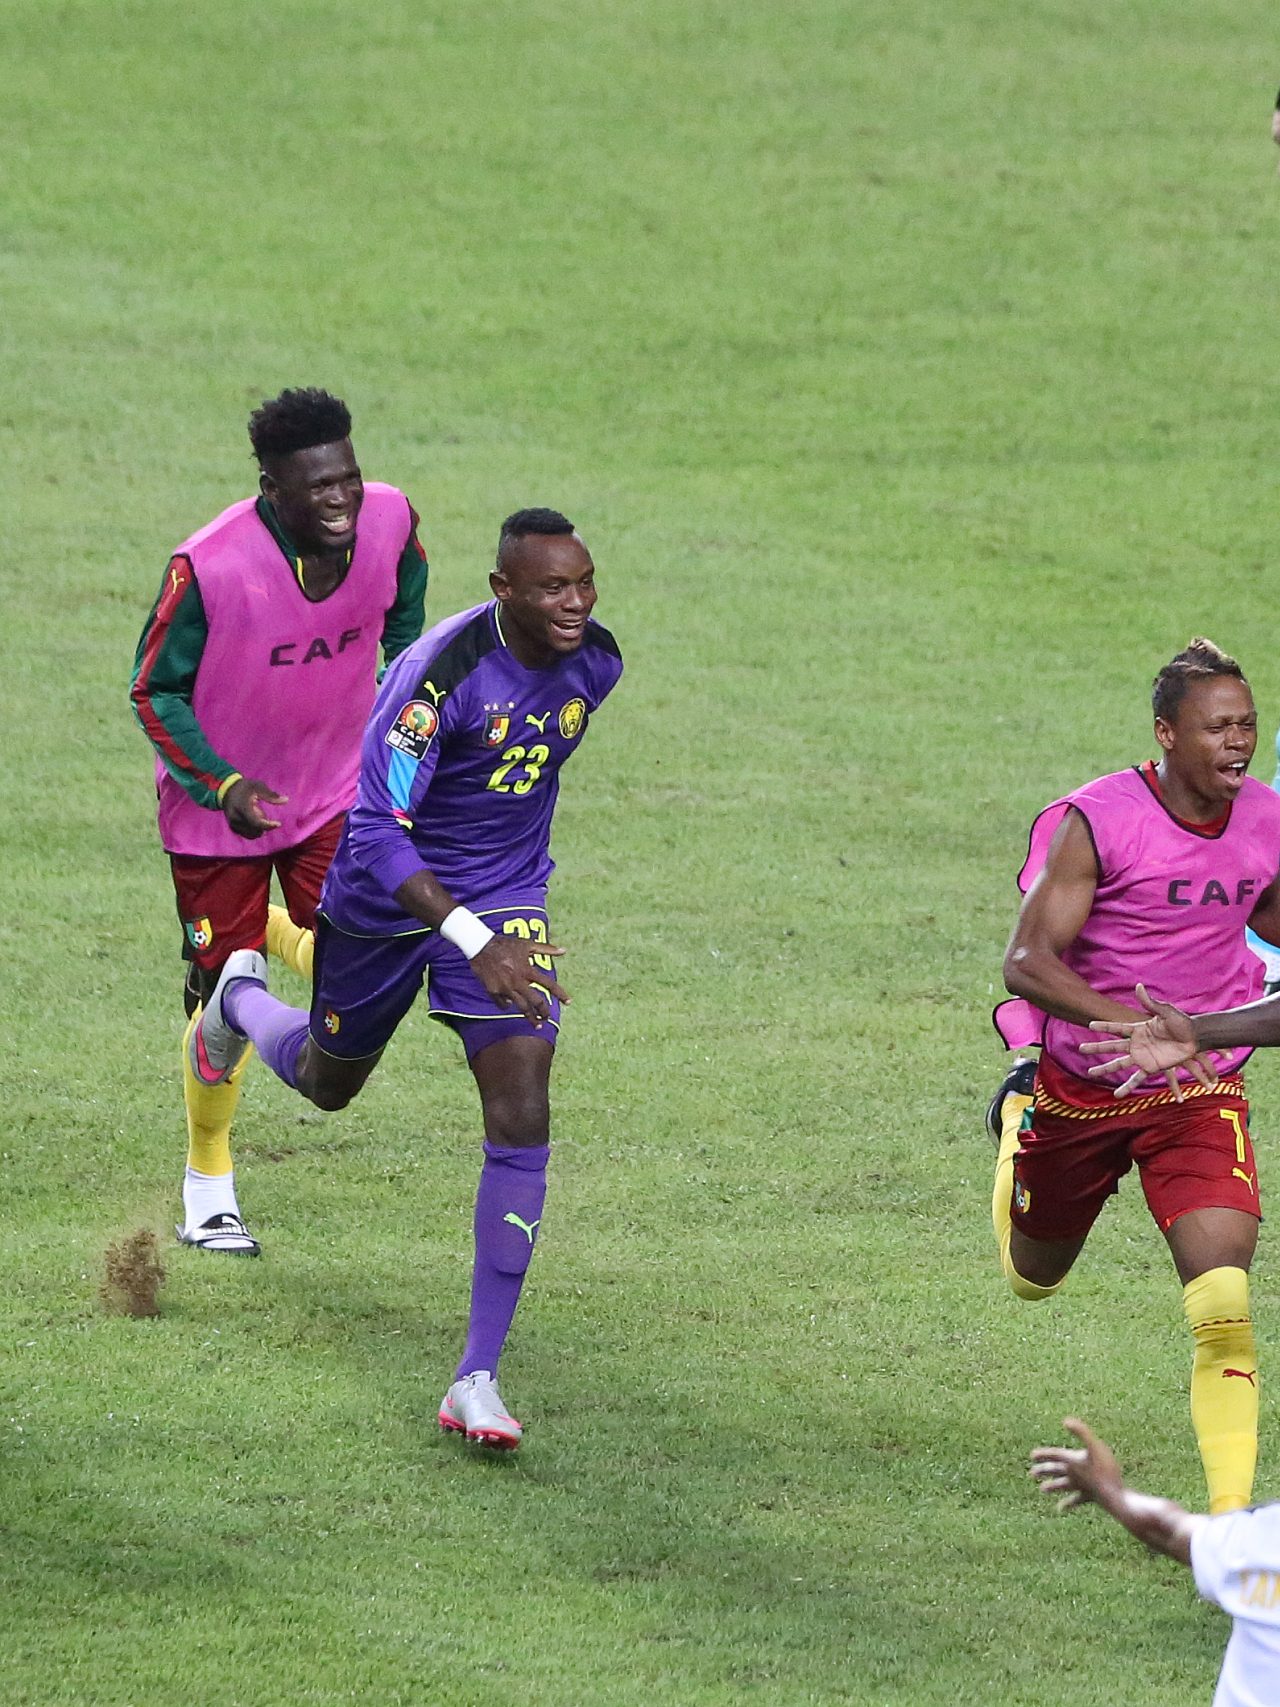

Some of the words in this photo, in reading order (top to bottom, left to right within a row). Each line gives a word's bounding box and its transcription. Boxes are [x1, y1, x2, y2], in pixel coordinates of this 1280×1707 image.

[268, 626, 362, 667] CAF
[485, 744, 550, 795] 23
[1167, 879, 1256, 906] CAF
[1219, 1108, 1246, 1163] 7
